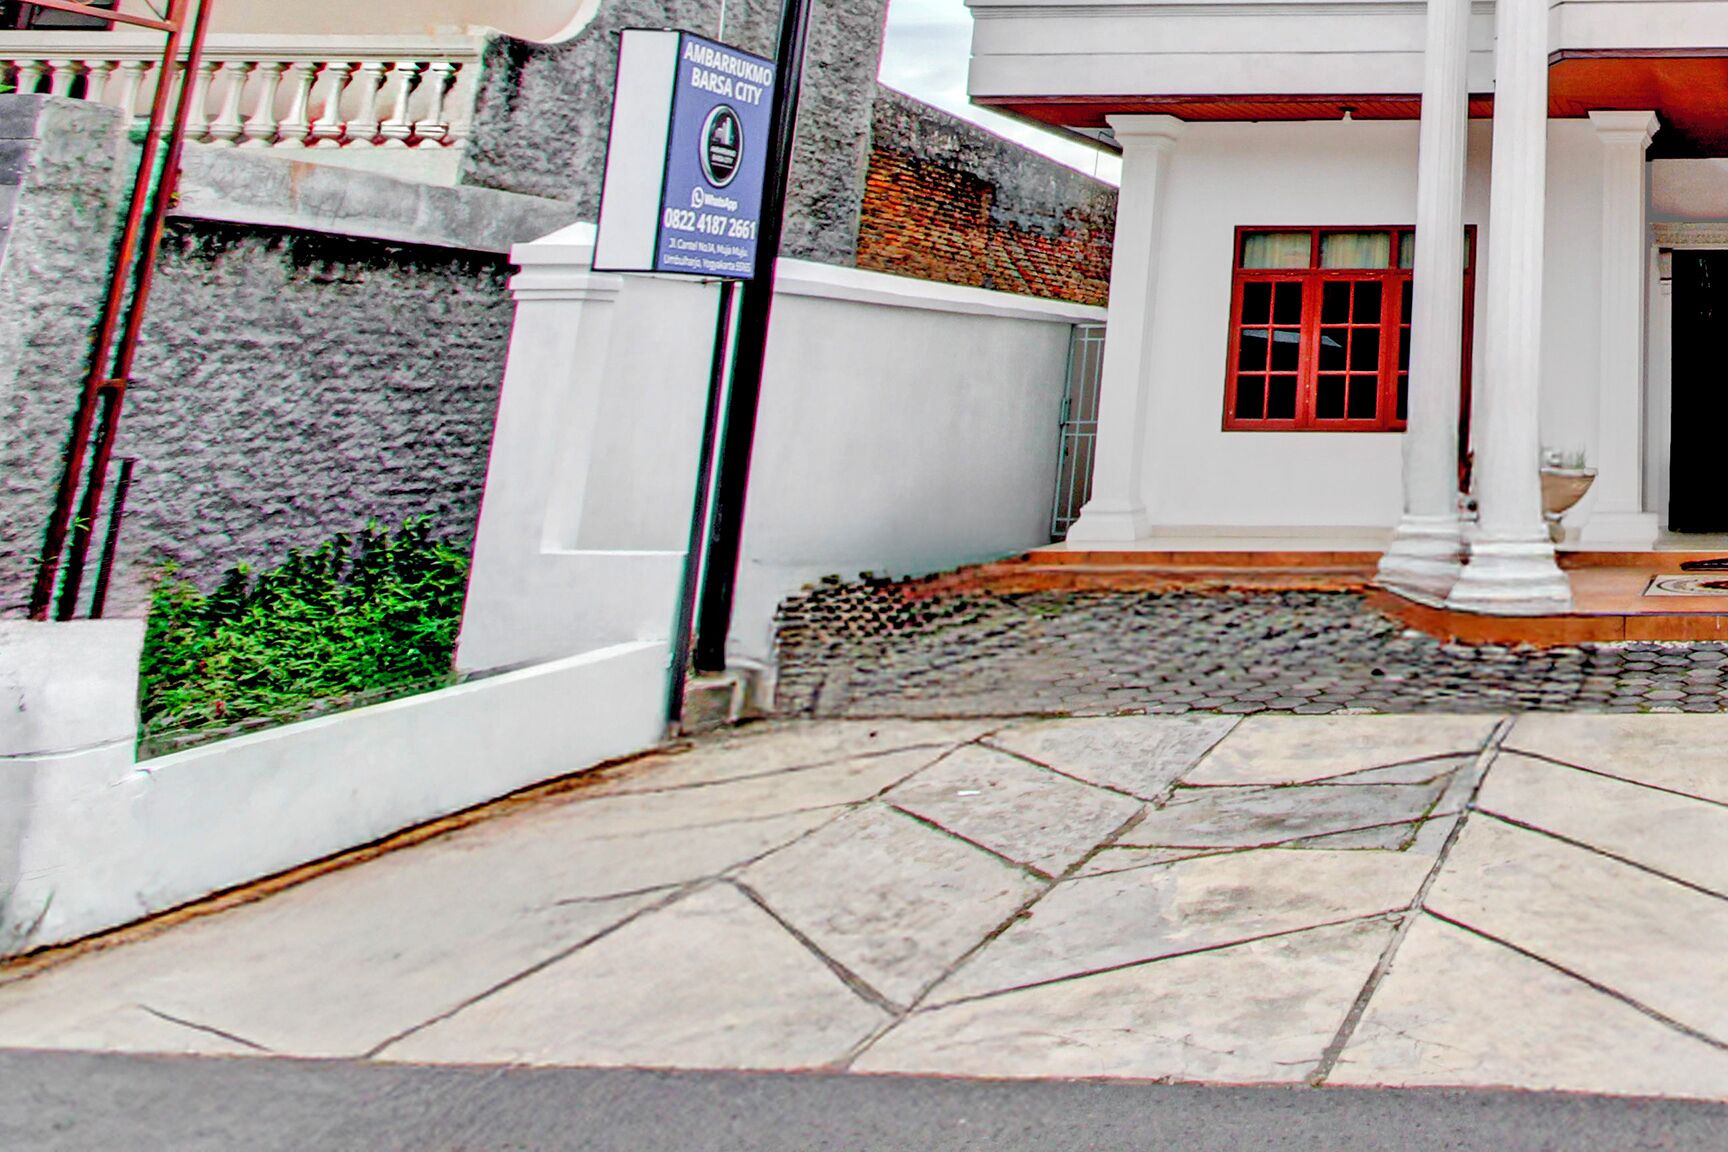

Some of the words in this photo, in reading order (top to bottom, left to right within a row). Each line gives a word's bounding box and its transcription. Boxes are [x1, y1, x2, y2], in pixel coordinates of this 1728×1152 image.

[684, 41, 773, 87] AMBARRUKMO
[691, 66, 733, 98] BARSA
[735, 81, 763, 105] CITY
[704, 192, 739, 212] WhatsApp
[664, 207, 695, 232] 0822
[697, 213, 728, 236] 4187
[727, 217, 756, 240] 2661
